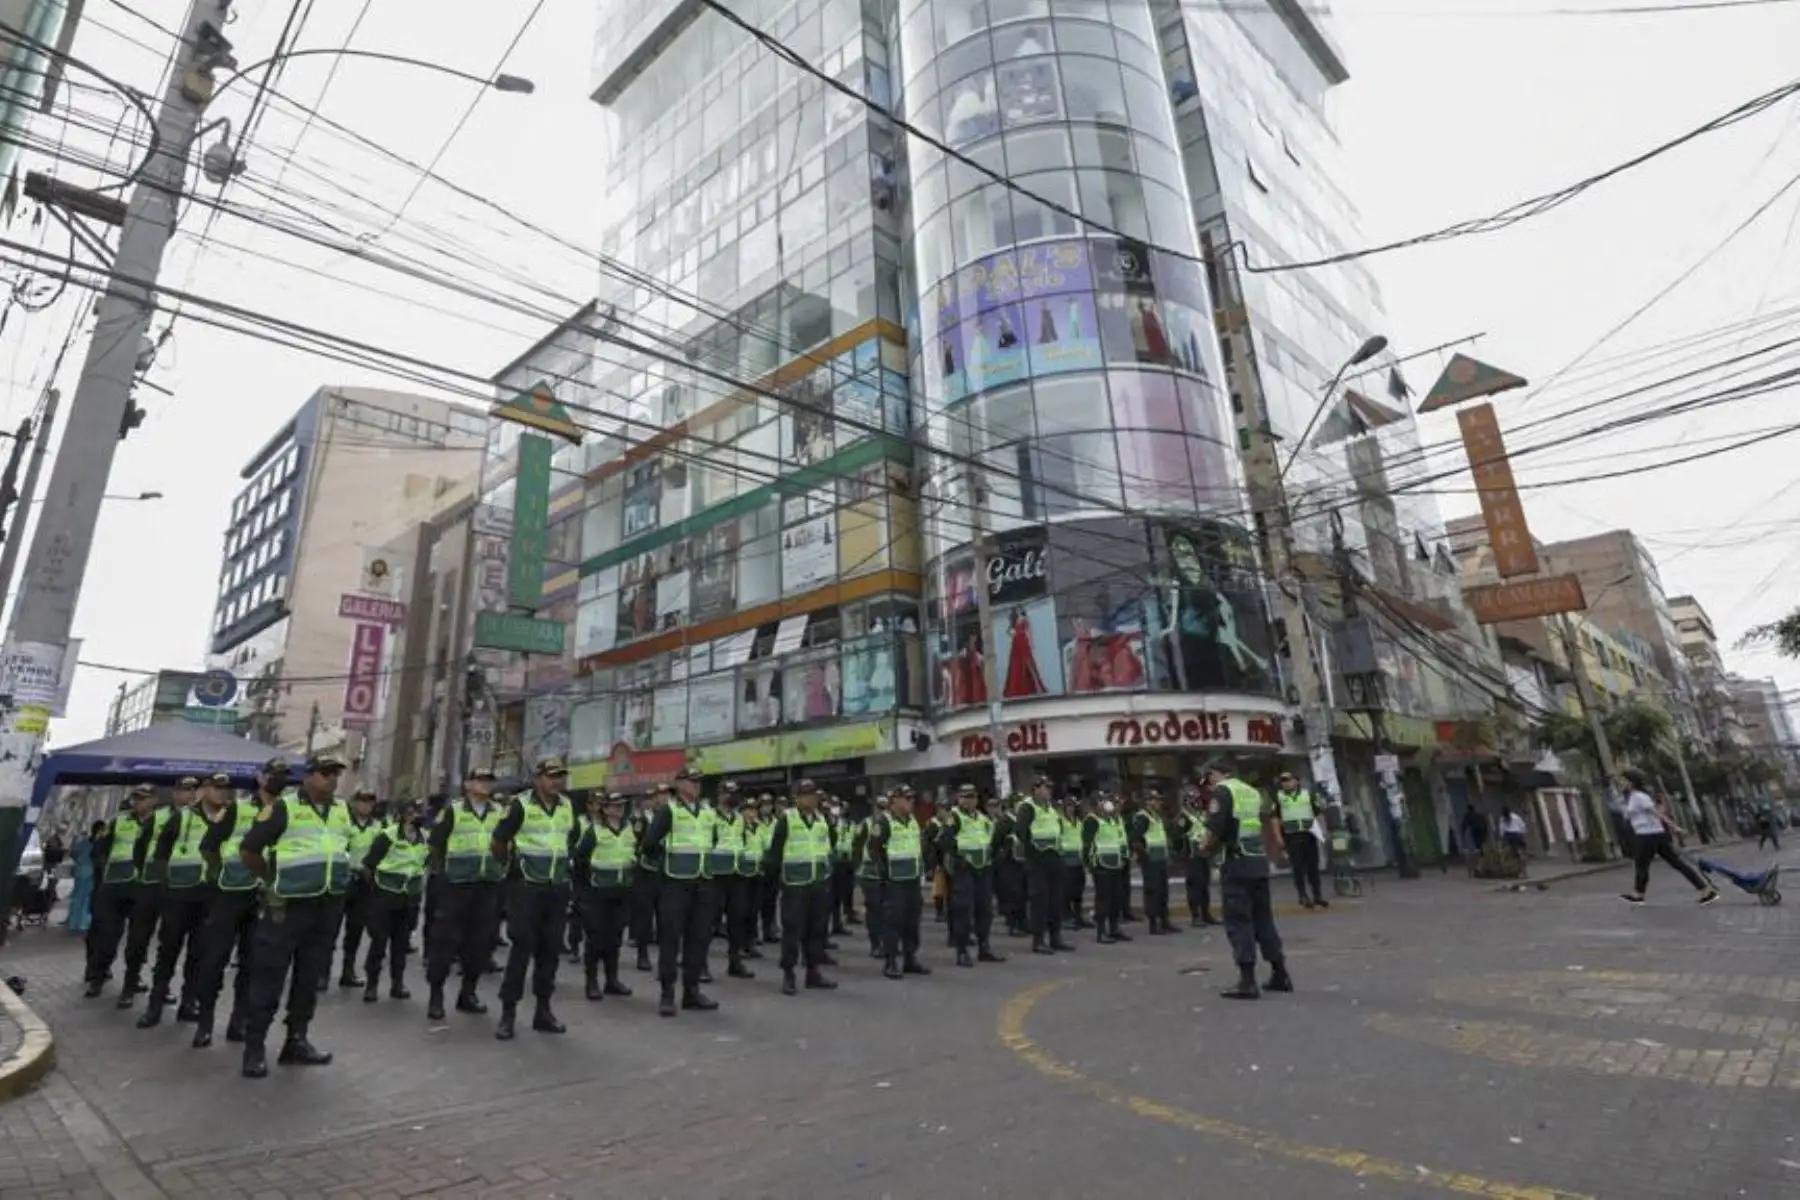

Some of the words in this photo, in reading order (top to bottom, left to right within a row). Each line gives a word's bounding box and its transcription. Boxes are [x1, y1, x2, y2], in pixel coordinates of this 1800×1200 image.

[342, 597, 403, 620] GALERIA
[349, 628, 378, 711] LEO
[961, 723, 1048, 759] moelli
[1106, 712, 1230, 746] modelli
